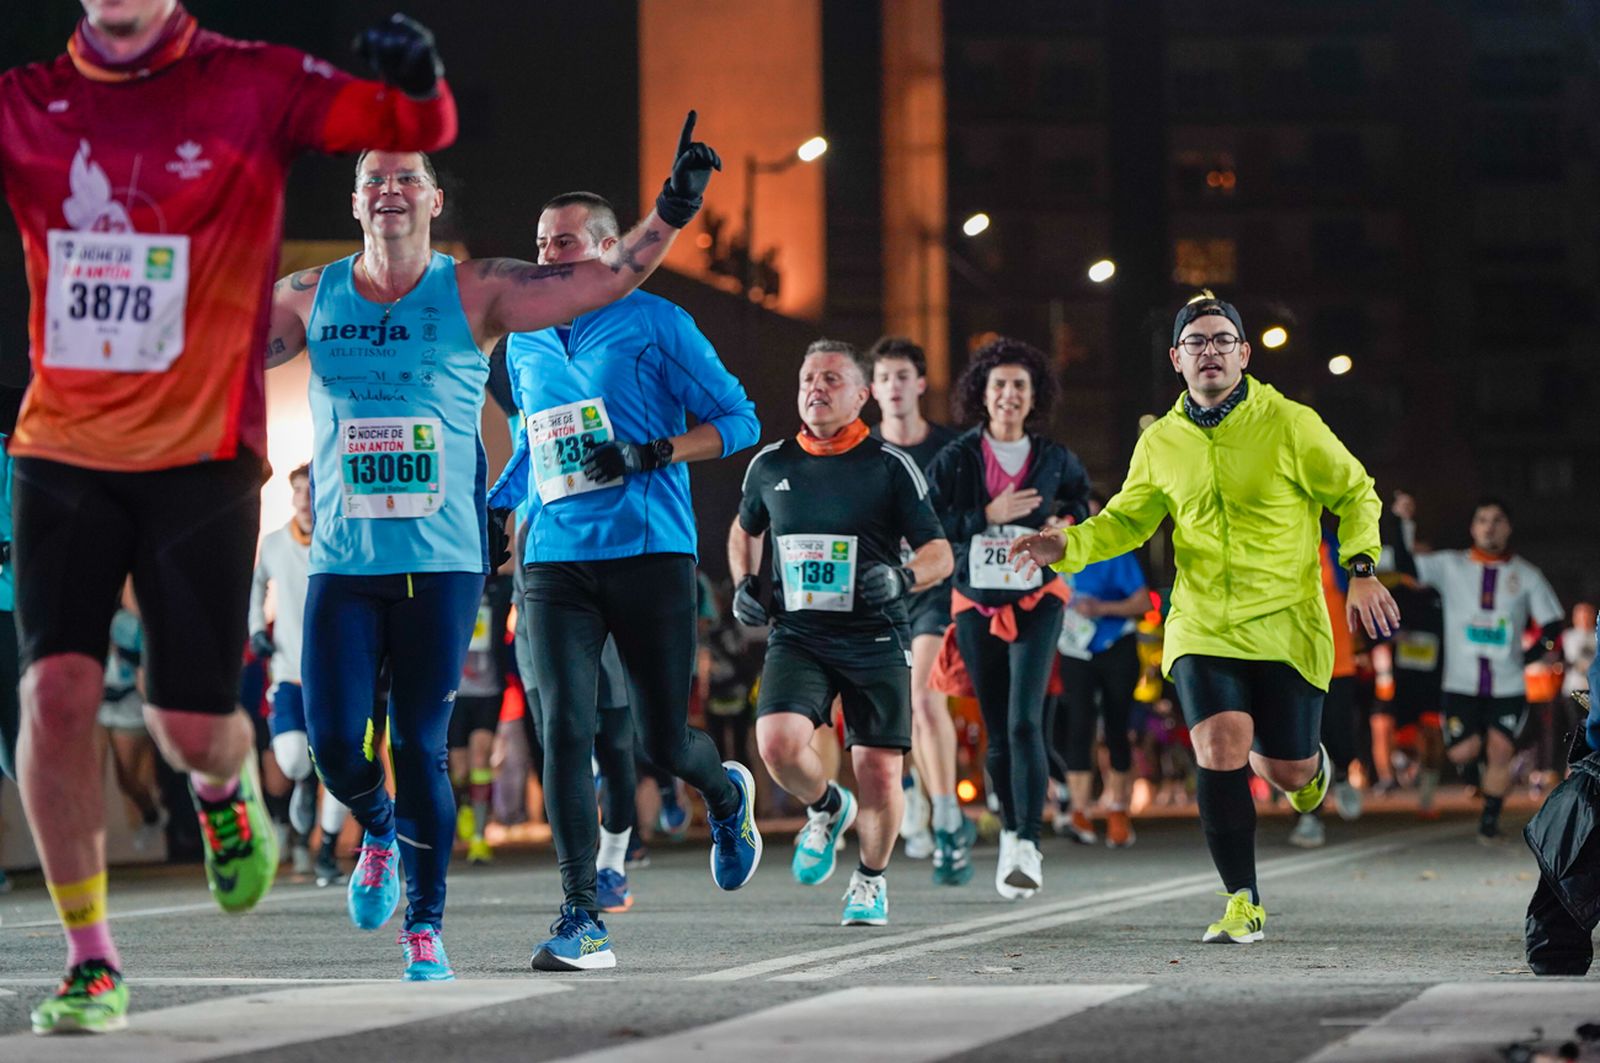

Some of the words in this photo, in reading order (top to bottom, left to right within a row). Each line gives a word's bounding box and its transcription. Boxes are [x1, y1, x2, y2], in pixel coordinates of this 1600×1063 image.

[69, 282, 152, 322] 3878
[320, 316, 410, 346] nerja
[328, 347, 397, 358] ATLETISMO
[348, 442, 367, 453] SAN
[368, 439, 404, 452] ANTÓN
[358, 429, 388, 439] NOCHE
[391, 428, 404, 439] DE
[347, 453, 432, 484] 13060
[792, 560, 836, 585] 138
